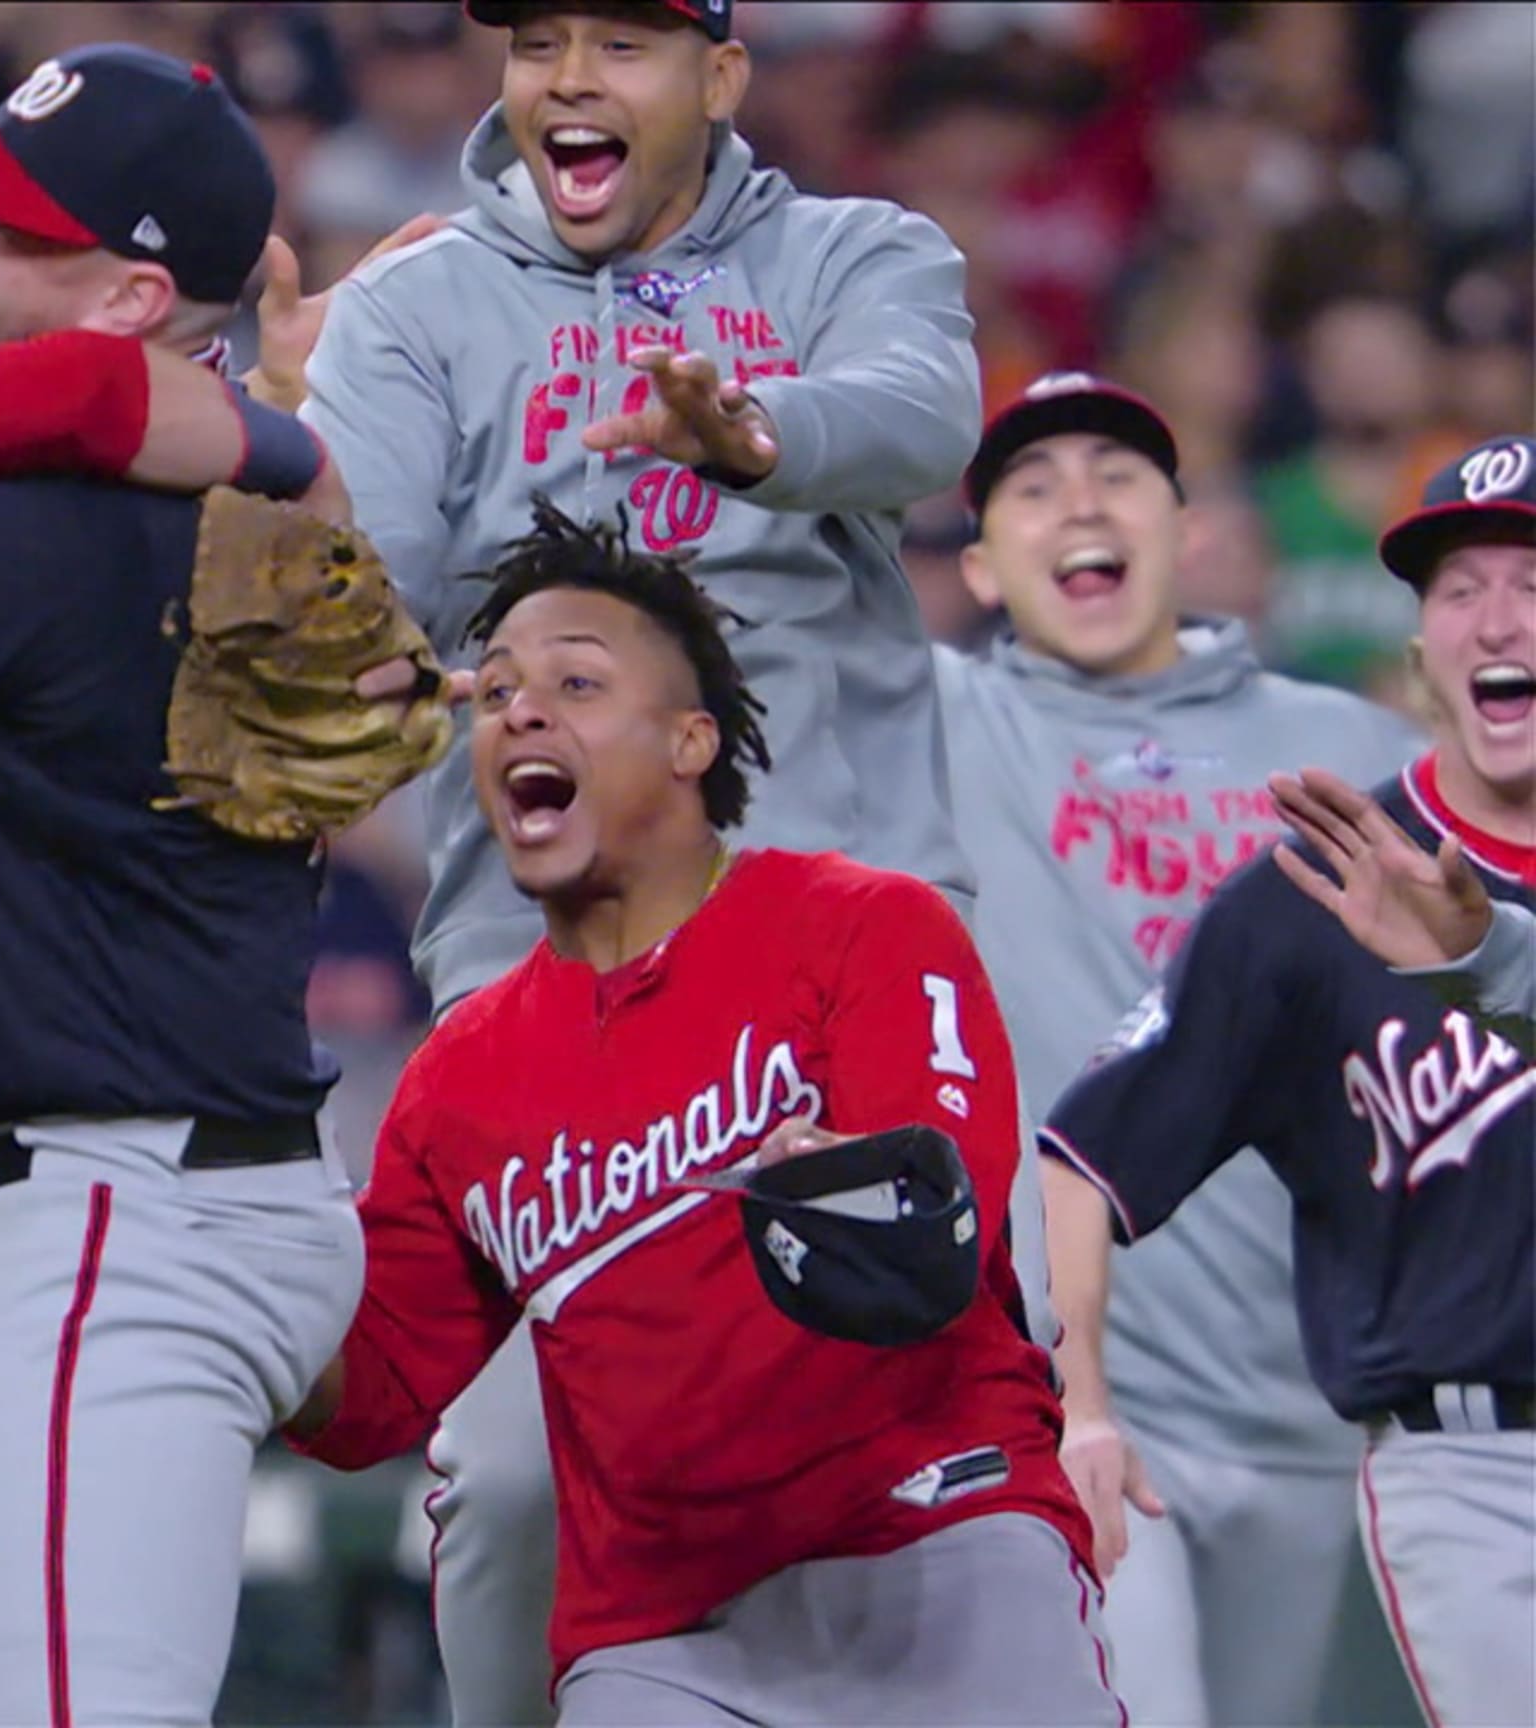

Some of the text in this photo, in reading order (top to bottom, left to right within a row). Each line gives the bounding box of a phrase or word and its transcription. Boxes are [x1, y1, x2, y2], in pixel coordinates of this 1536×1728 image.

[628, 465, 720, 553] W
[1458, 442, 1532, 504] W
[921, 972, 979, 1081] 1
[462, 1022, 823, 1290] Nationals
